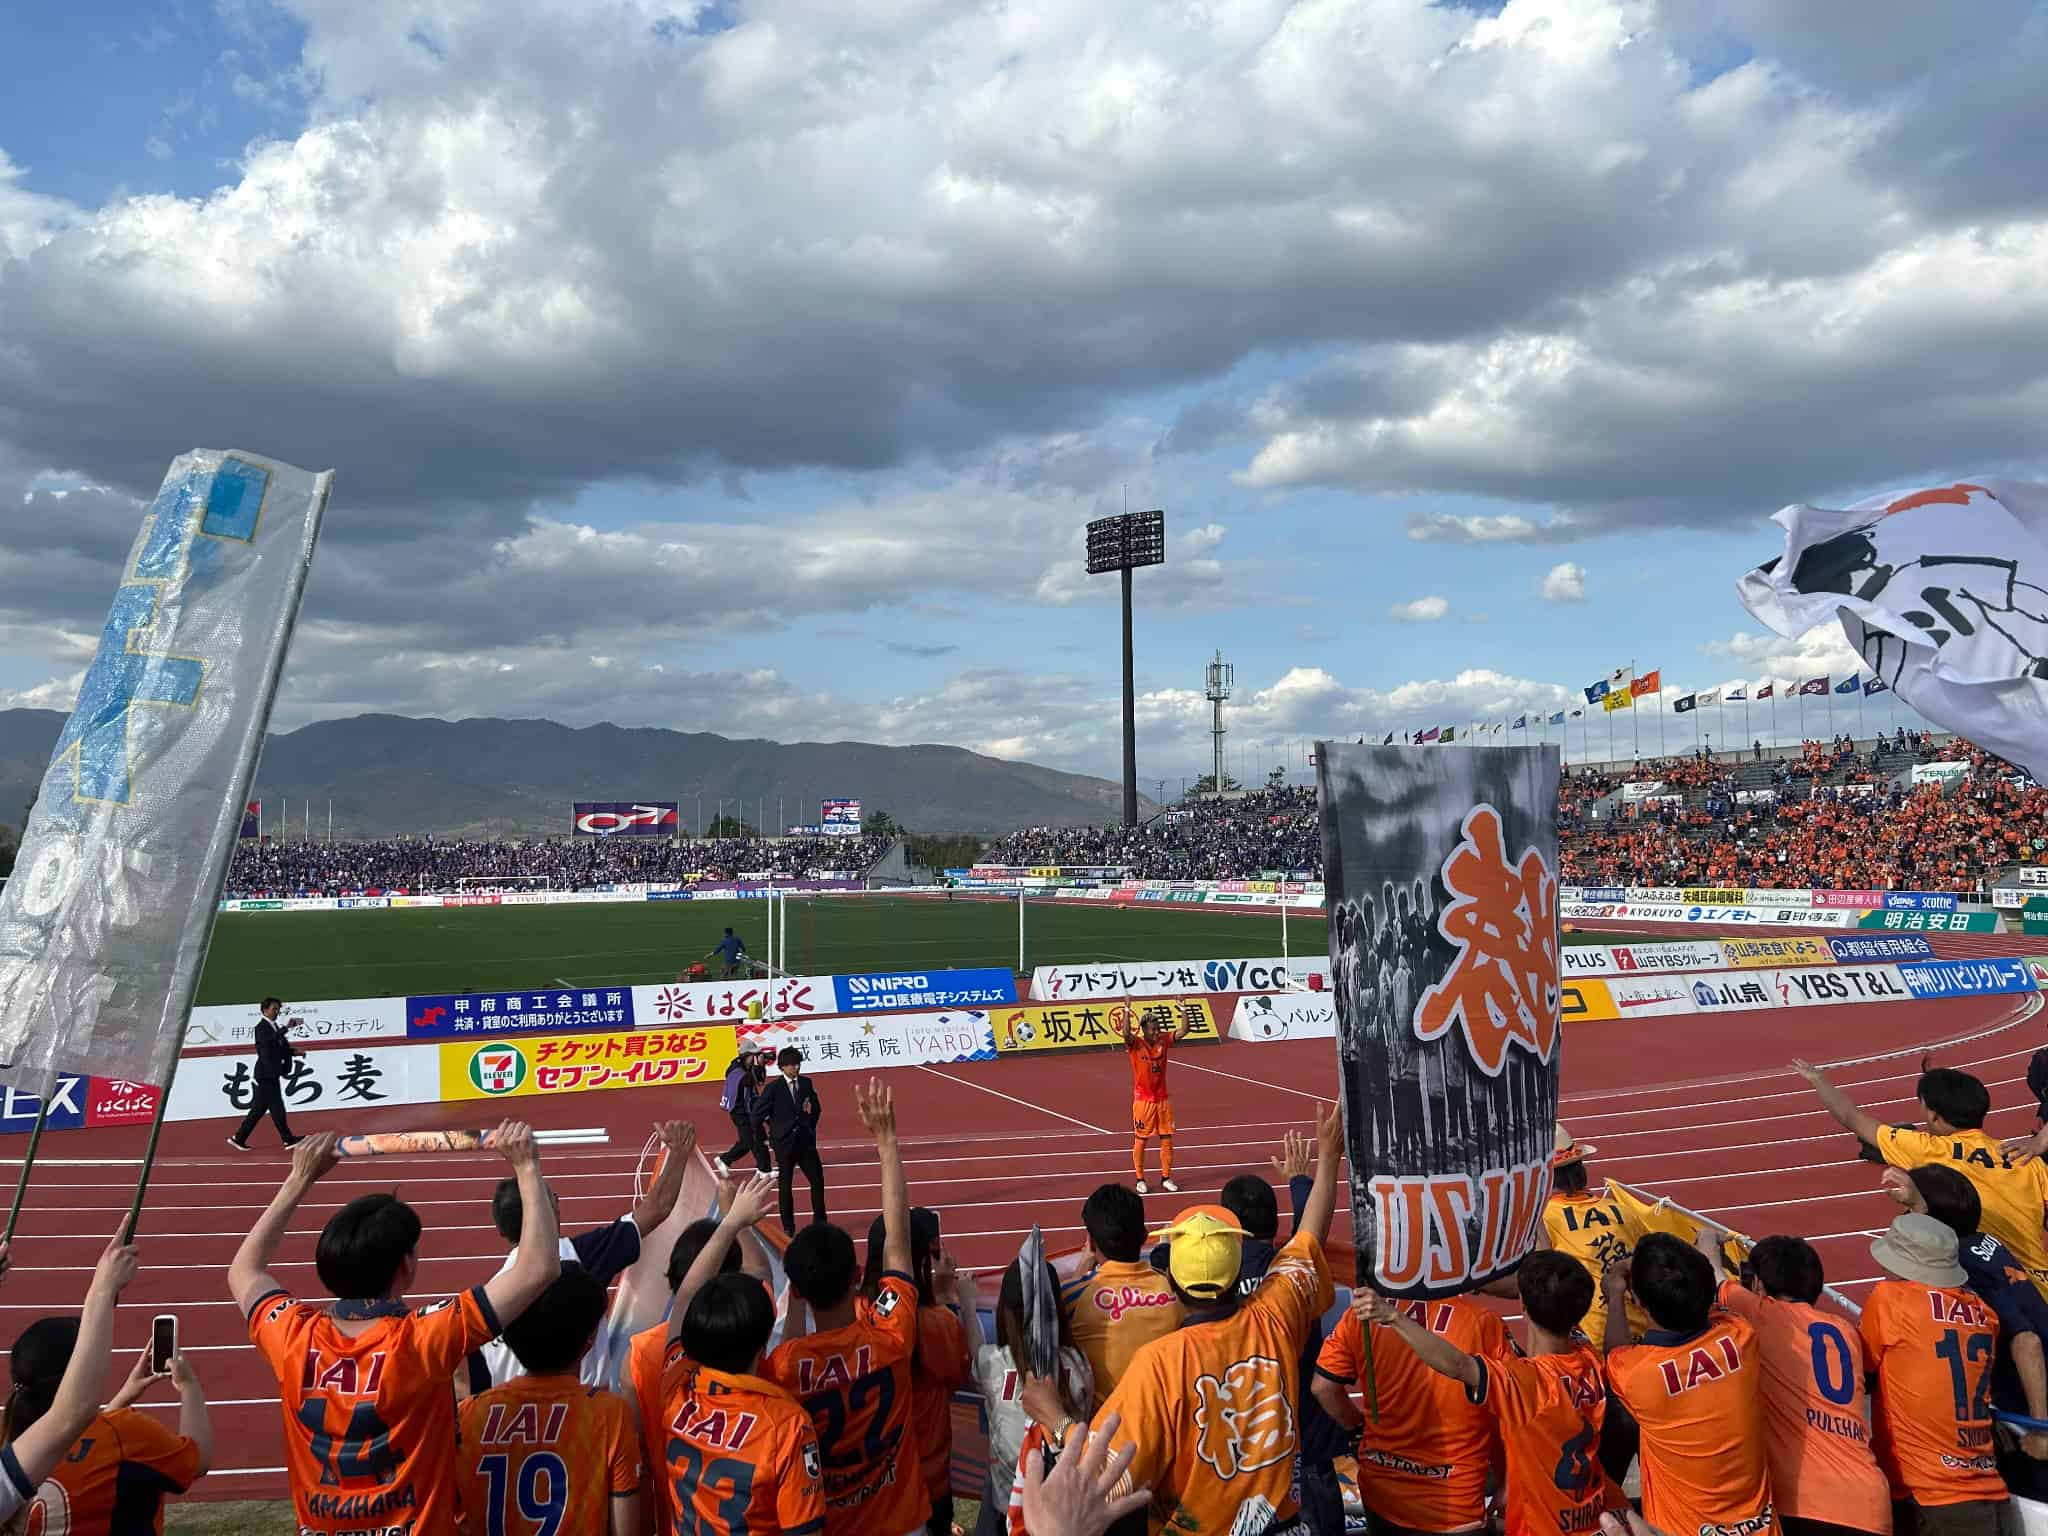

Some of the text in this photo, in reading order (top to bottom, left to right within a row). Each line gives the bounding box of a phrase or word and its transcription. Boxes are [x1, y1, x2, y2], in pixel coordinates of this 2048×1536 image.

[1629, 908, 1683, 918] KYOKUYO
[1704, 909, 1757, 920] エノモト
[1884, 912, 1970, 931] 明治安田
[1564, 951, 1606, 969] PLUS
[871, 975, 929, 992] NIPRO
[1064, 967, 1199, 992] アドブレーン社
[1790, 970, 1904, 1000] YBS T&L
[1902, 960, 2028, 995] 甲州リハビリグループ
[454, 992, 622, 1014] 甲府商工会議所
[706, 979, 815, 1017] はくばく
[851, 988, 1005, 1009] ニプロ医療電子システムズ
[1041, 1007, 1108, 1043] 坂本
[535, 1031, 708, 1063] チケット買うなら
[912, 1033, 973, 1053] YARD
[1562, 1204, 1625, 1232] IAI
[1094, 1288, 1178, 1322] Glico
[301, 1348, 387, 1396] IAI
[800, 1343, 874, 1395] IAI
[1658, 1335, 1743, 1398] IAI
[1808, 1321, 1855, 1406] 0
[1935, 1328, 1994, 1423] 12
[481, 1403, 569, 1445] IAI
[672, 1399, 758, 1451] IAI
[475, 1450, 569, 1536] 19
